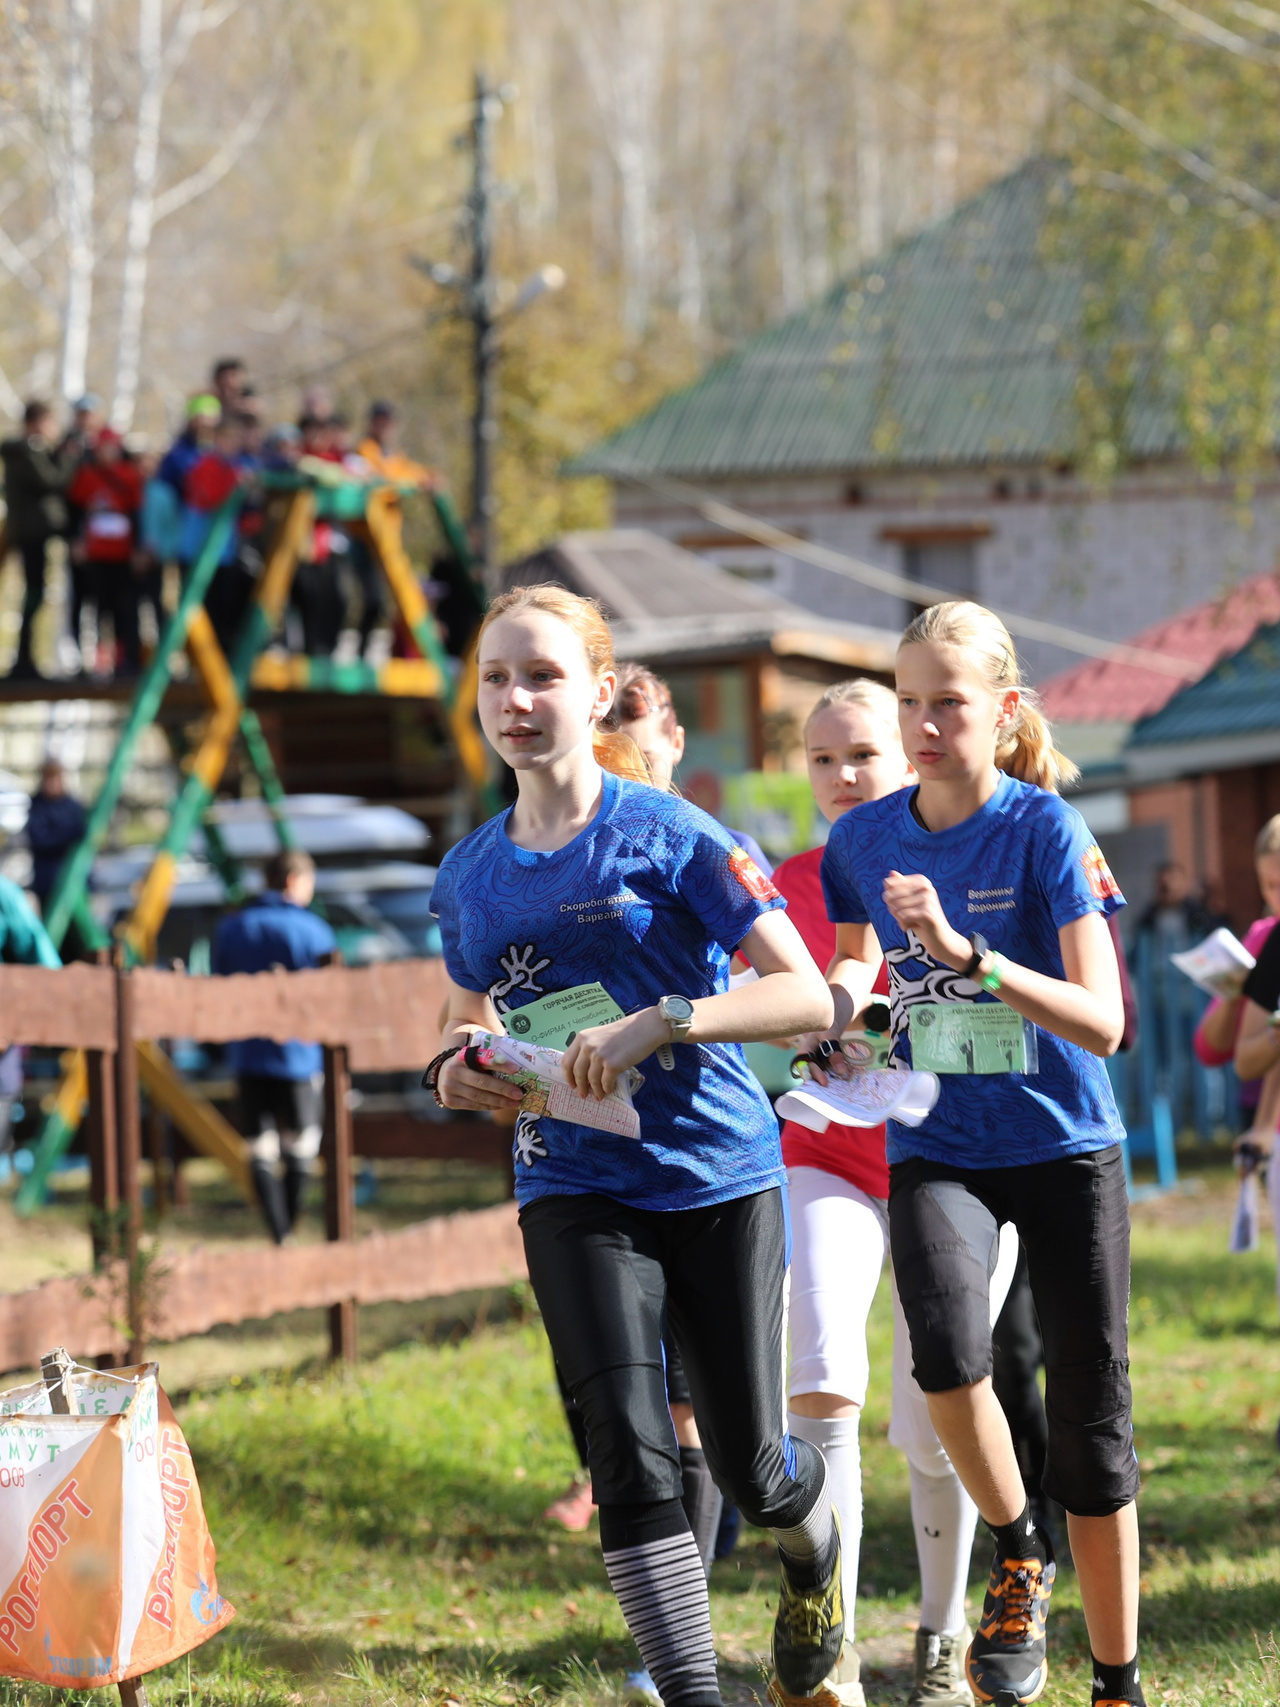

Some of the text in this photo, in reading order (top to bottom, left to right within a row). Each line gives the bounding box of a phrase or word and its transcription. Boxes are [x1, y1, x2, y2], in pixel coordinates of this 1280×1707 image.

[559, 892, 636, 913] Скоробогатова
[577, 909, 624, 924] Варвара
[542, 987, 602, 1011] ГОРЯЧАЯ ДЕСЯТКА
[531, 1024, 567, 1043] О-ФИРМА
[960, 1039, 975, 1075] 1
[0, 1443, 61, 1463] МУТ
